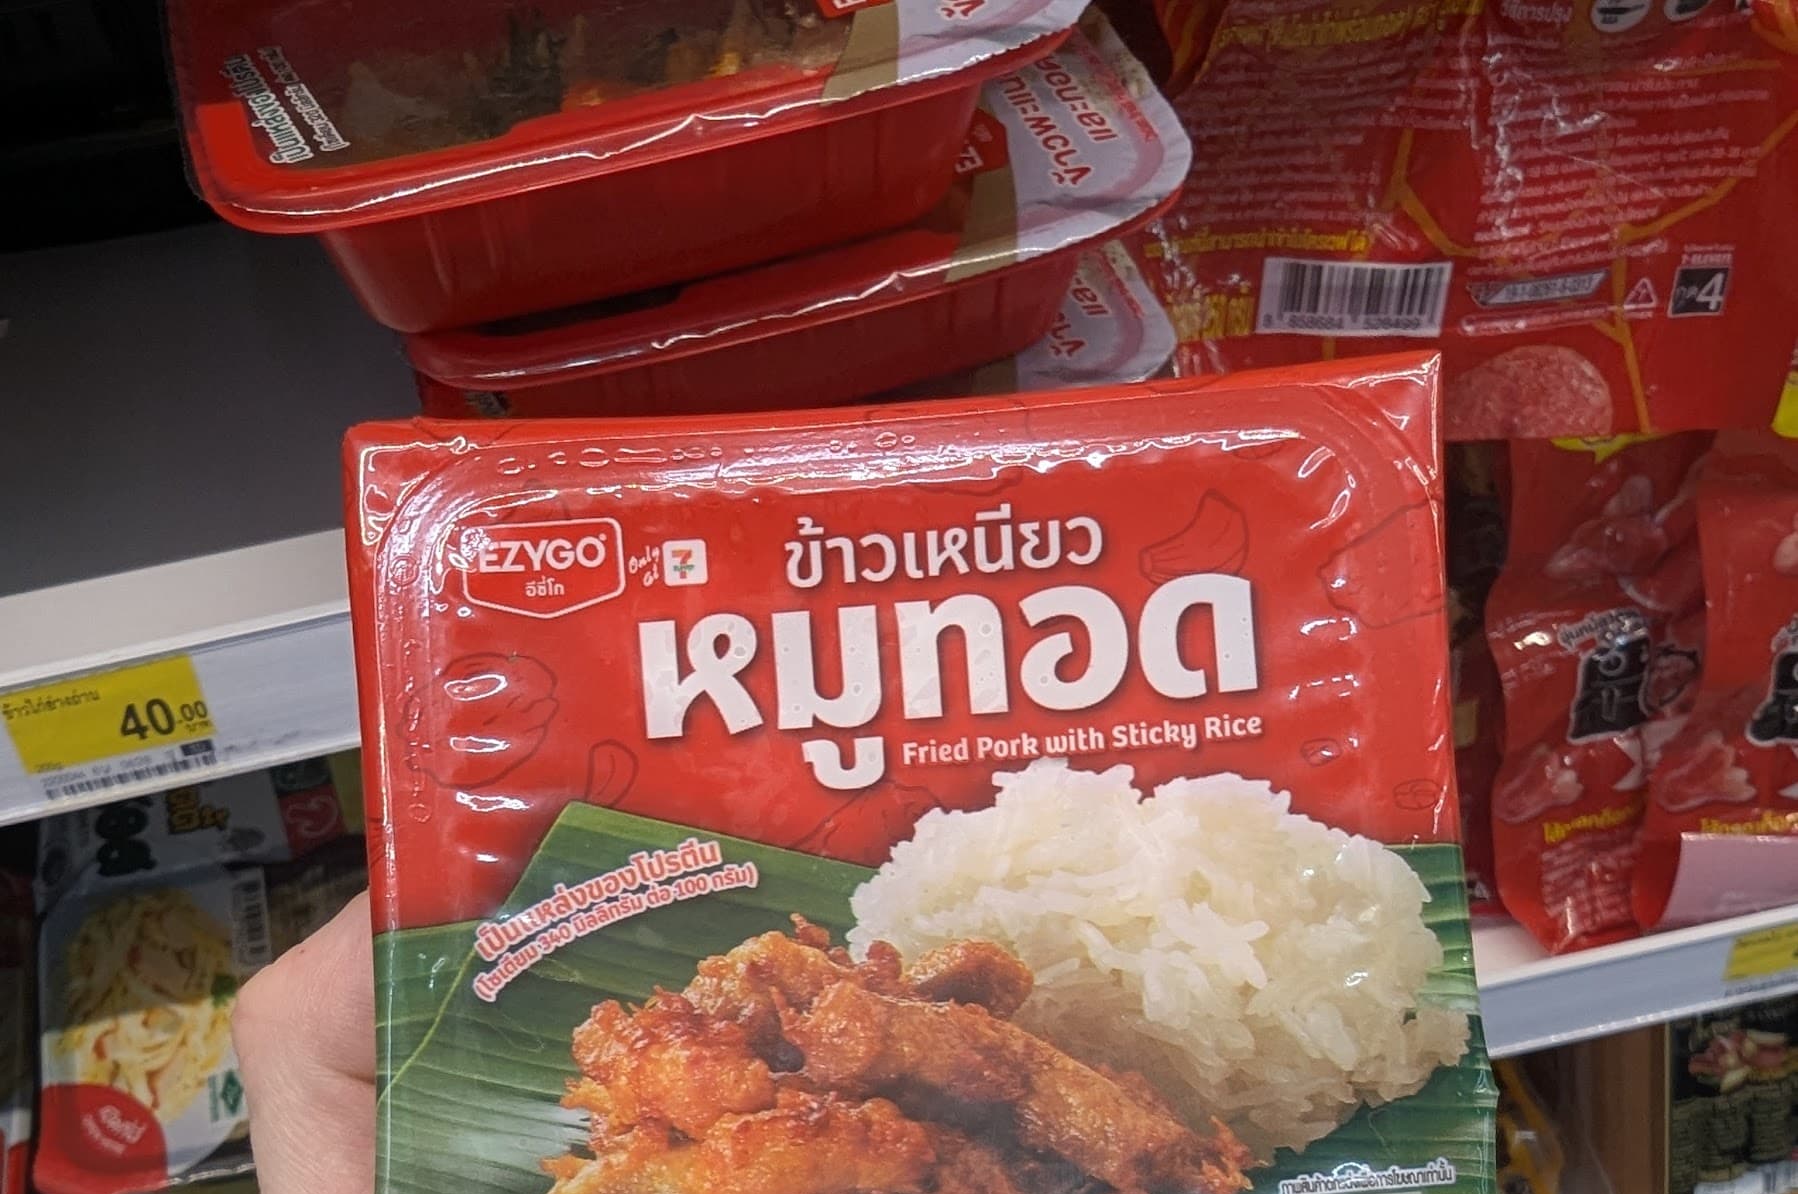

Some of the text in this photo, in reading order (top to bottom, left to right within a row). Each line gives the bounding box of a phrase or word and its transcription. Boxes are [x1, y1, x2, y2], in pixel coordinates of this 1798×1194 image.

[1696, 272, 1725, 310] 4
[479, 537, 605, 573] EZYGO
[785, 504, 1103, 589] ข้าวเหนียว
[525, 574, 564, 597] อีซี่โก
[638, 572, 1258, 790] หมูทอด
[902, 714, 1263, 765] Fried Pork with Sticky Rice
[472, 862, 759, 1003] (โซเดียม 340 มิลลิกรัม ต่อ 100 กรัม)
[474, 837, 722, 962] เป็นแหล่งของโปรตีน
